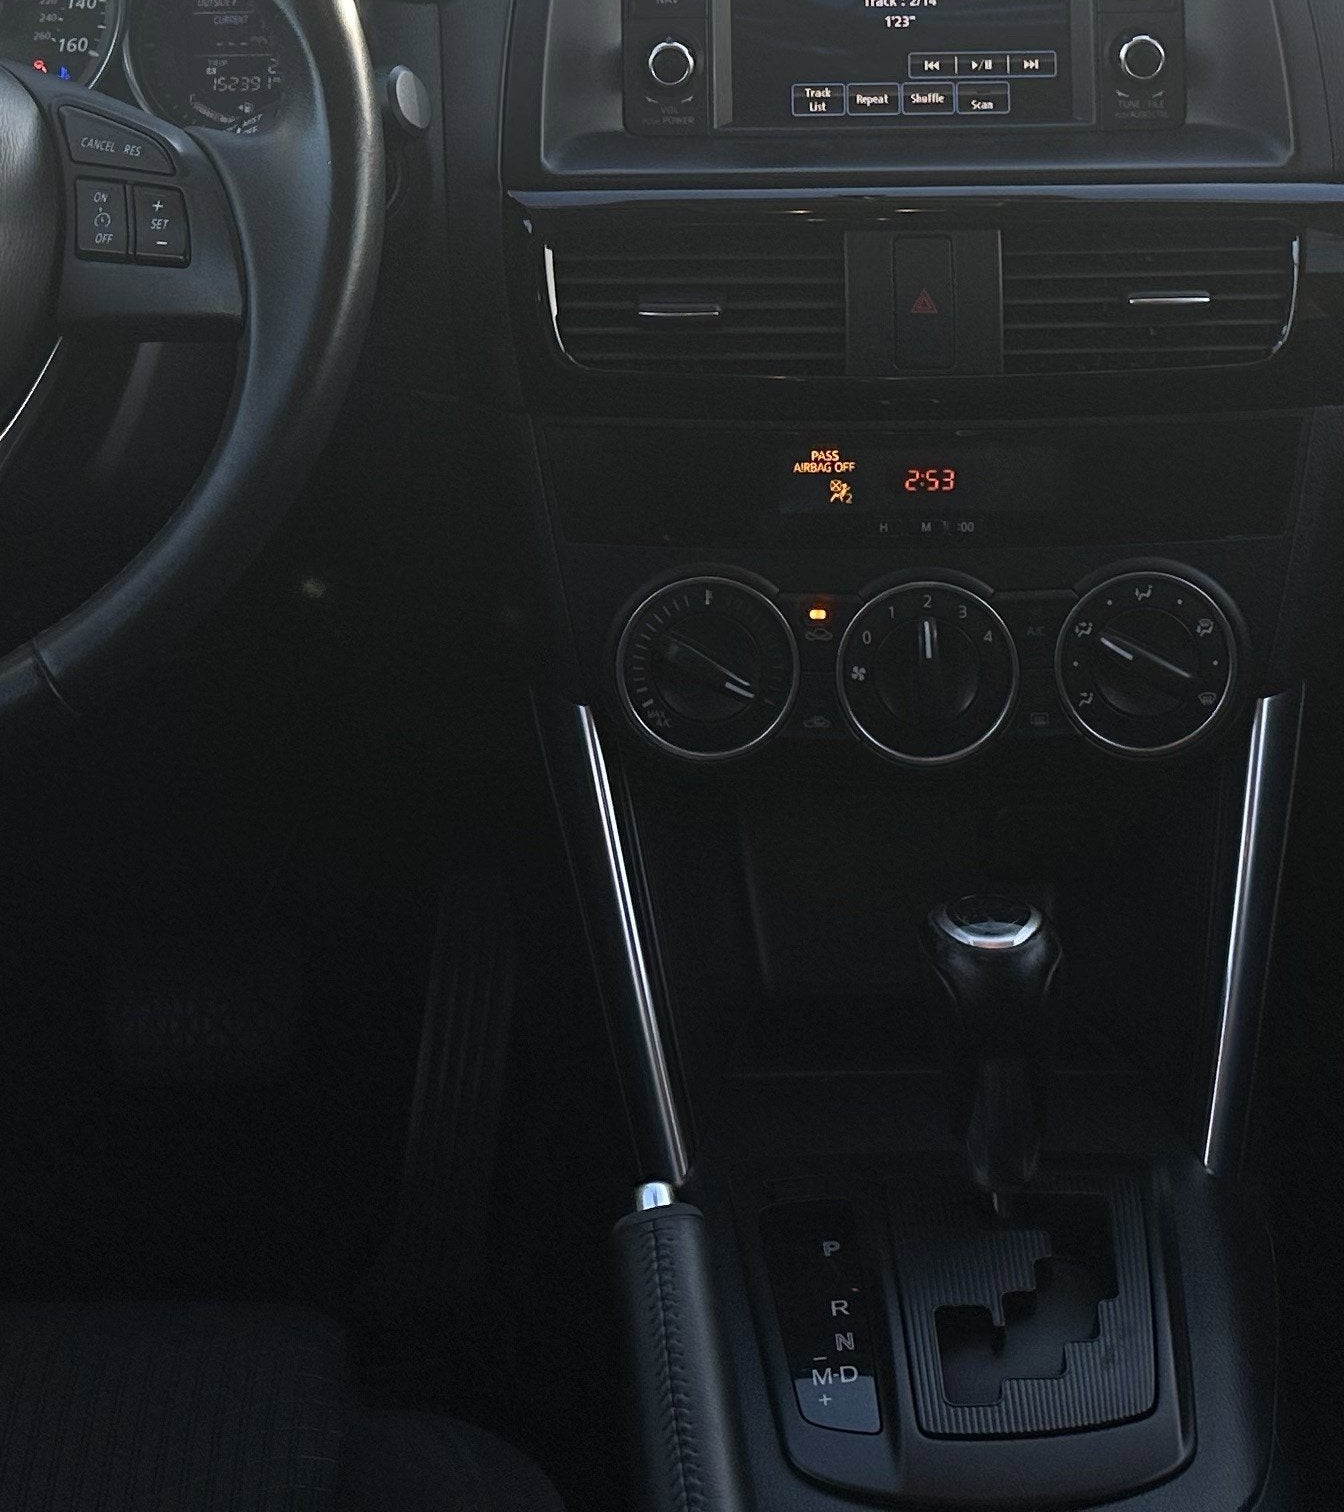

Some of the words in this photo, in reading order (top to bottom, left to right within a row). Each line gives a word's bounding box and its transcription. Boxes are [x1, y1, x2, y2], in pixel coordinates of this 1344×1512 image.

[38, 13, 57, 23] 240
[33, 32, 53, 42] 260
[58, 37, 89, 53] 160
[804, 87, 832, 99] Track
[909, 92, 945, 106] Shuffle
[809, 100, 827, 113] List
[855, 92, 890, 108] Repeat
[970, 98, 994, 111] Scan
[80, 136, 117, 154] CANCEL
[122, 144, 143, 159] RES
[91, 191, 109, 205] ON
[149, 217, 169, 230] SET
[94, 231, 114, 244] OFF
[810, 450, 840, 462] PASS
[793, 462, 832, 473] AIRBAG
[834, 462, 856, 473] OFF
[904, 469, 956, 492] 2:53
[921, 521, 932, 532] M
[922, 594, 932, 609] 2
[888, 606, 896, 619] 1
[958, 605, 968, 619] 3
[861, 631, 872, 644] 0
[982, 630, 994, 644] 4
[822, 1241, 841, 1257] P
[831, 1299, 849, 1316] R
[835, 1332, 855, 1351] N
